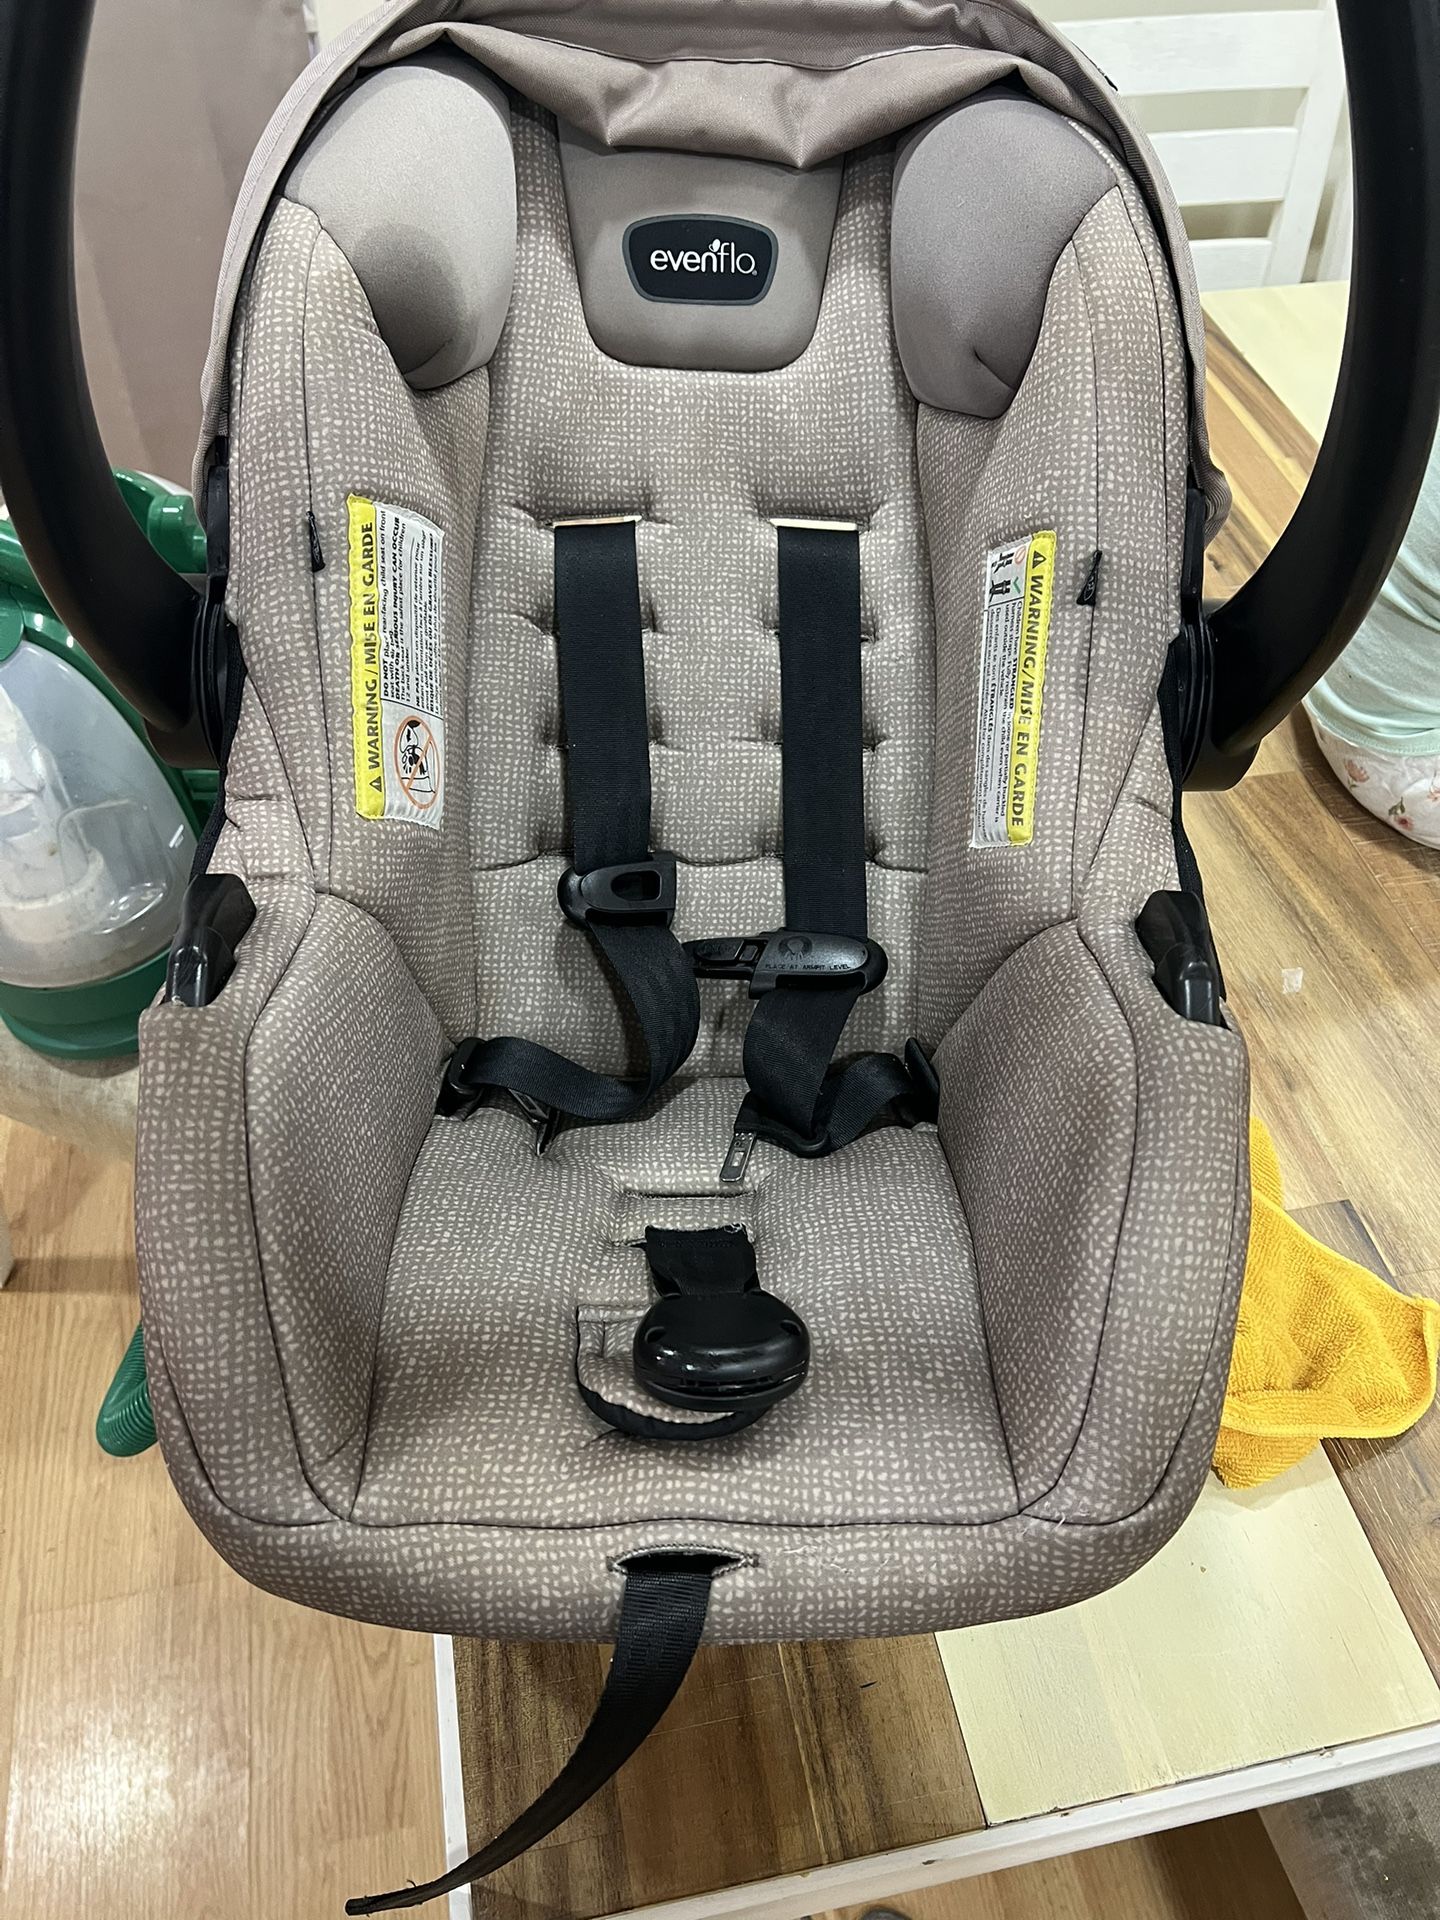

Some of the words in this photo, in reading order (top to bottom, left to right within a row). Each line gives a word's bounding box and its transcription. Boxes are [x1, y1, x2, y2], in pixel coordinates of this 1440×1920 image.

[650, 239, 756, 274] evenflo
[362, 522, 374, 586] GARDE
[380, 534, 385, 544] on
[398, 523, 406, 557] children
[363, 593, 375, 616] EN
[363, 622, 376, 664] MISE
[394, 652, 400, 665] OR
[384, 682, 388, 697] DO
[1009, 658, 1017, 709] STRANGLED
[366, 679, 380, 770] WARNING
[1016, 732, 1029, 756] EN
[1012, 763, 1026, 826] GARDE
